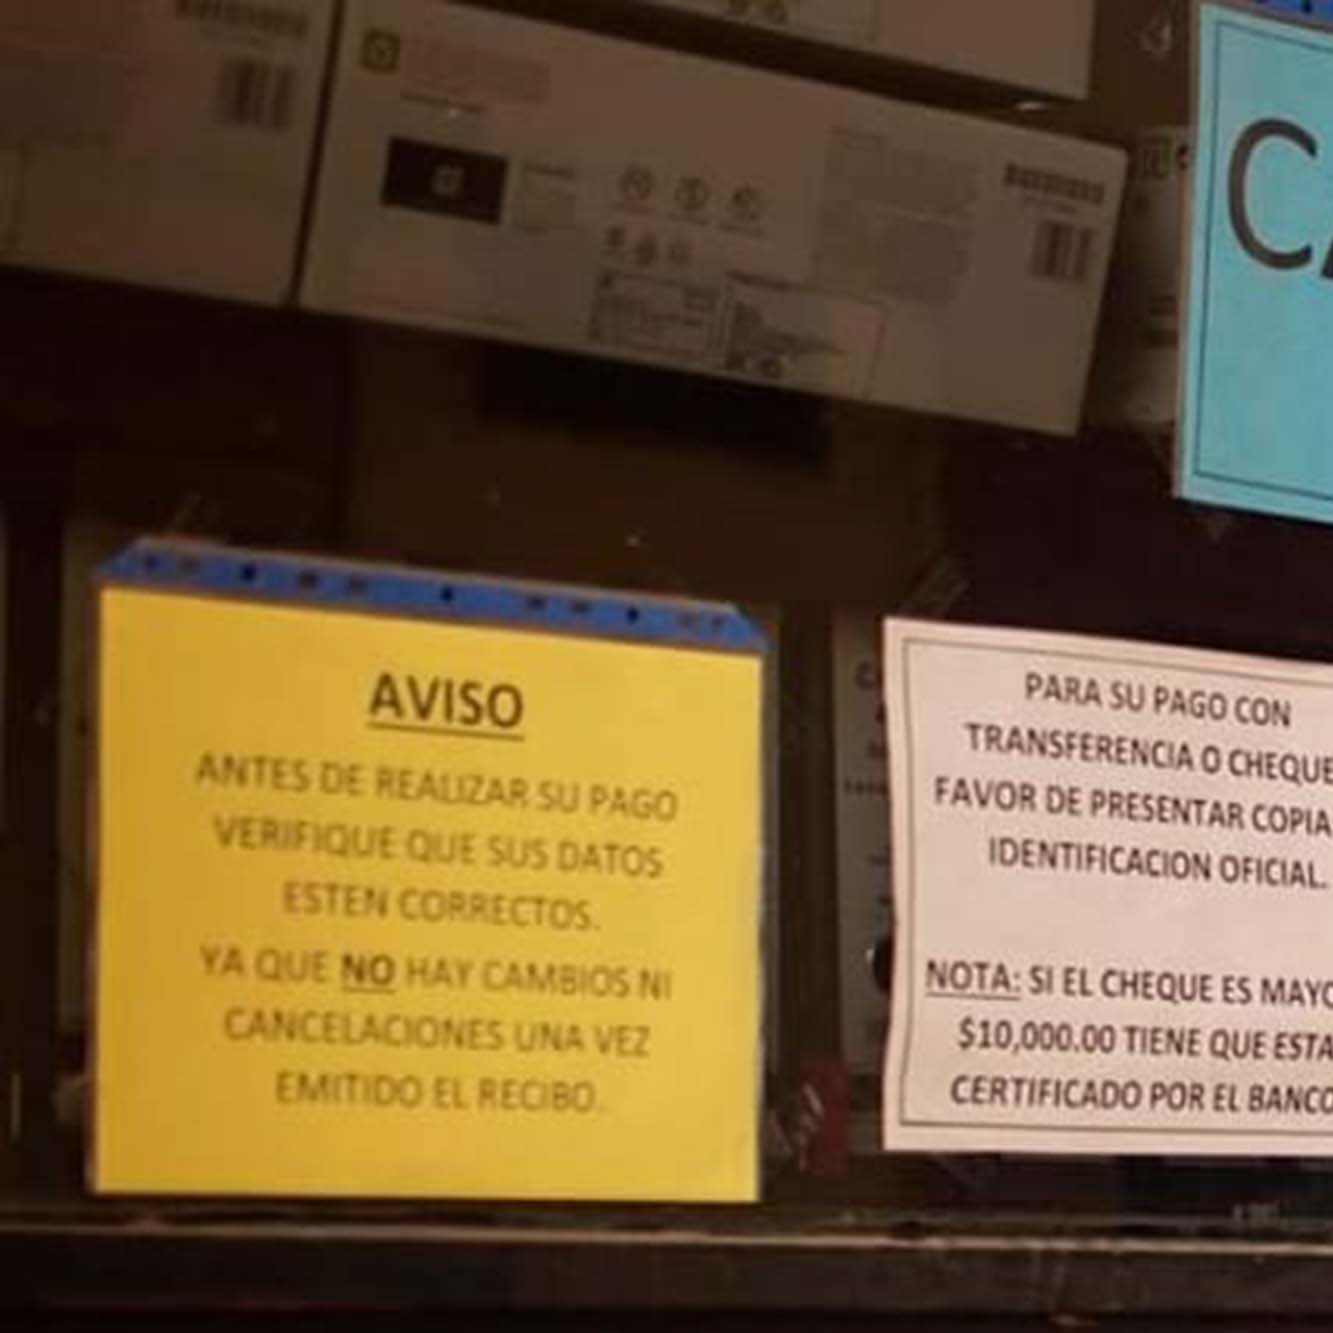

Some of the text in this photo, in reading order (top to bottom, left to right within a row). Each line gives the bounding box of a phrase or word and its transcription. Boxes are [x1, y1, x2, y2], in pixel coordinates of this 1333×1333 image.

[367, 671, 525, 729] AVISO
[1026, 672, 1292, 728] PARA SU PAGO CON
[965, 723, 1194, 773] TRANSFERENCIA
[1202, 745, 1220, 773] O
[194, 751, 678, 822] ANTES DE REALIZAR SU PAGO
[933, 776, 1037, 812] FAVOR
[1046, 785, 1081, 817] DE
[1090, 789, 1245, 833] PRESENTAR
[1252, 803, 1332, 837] COPIA
[213, 815, 663, 880] VERIFIQUE QUE SUS DATOS
[988, 837, 1330, 890] IDENTIFICACION OFICIAL.
[282, 880, 599, 932] ESTEN CORRECTOS.
[199, 944, 673, 1001] YA QUE NO HAY CAMBIOS NI
[925, 960, 1021, 994] NOTA:
[1030, 966, 1055, 996] SI
[1064, 968, 1094, 997] EL
[1101, 969, 1213, 1005] CHEQUE
[1222, 977, 1252, 1005] ES
[223, 1006, 652, 1058] CANCELACIONES UNA VEZ
[958, 1017, 1116, 1056] $10,000.00
[1125, 1028, 1201, 1058] TIENE
[1209, 1029, 1267, 1061] QUE
[276, 1070, 424, 1111] EMITIDO
[434, 1078, 469, 1111] EL
[951, 1074, 1144, 1110] CERTIFICADO
[1149, 1080, 1206, 1112] POR
[1213, 1084, 1241, 1114] EL
